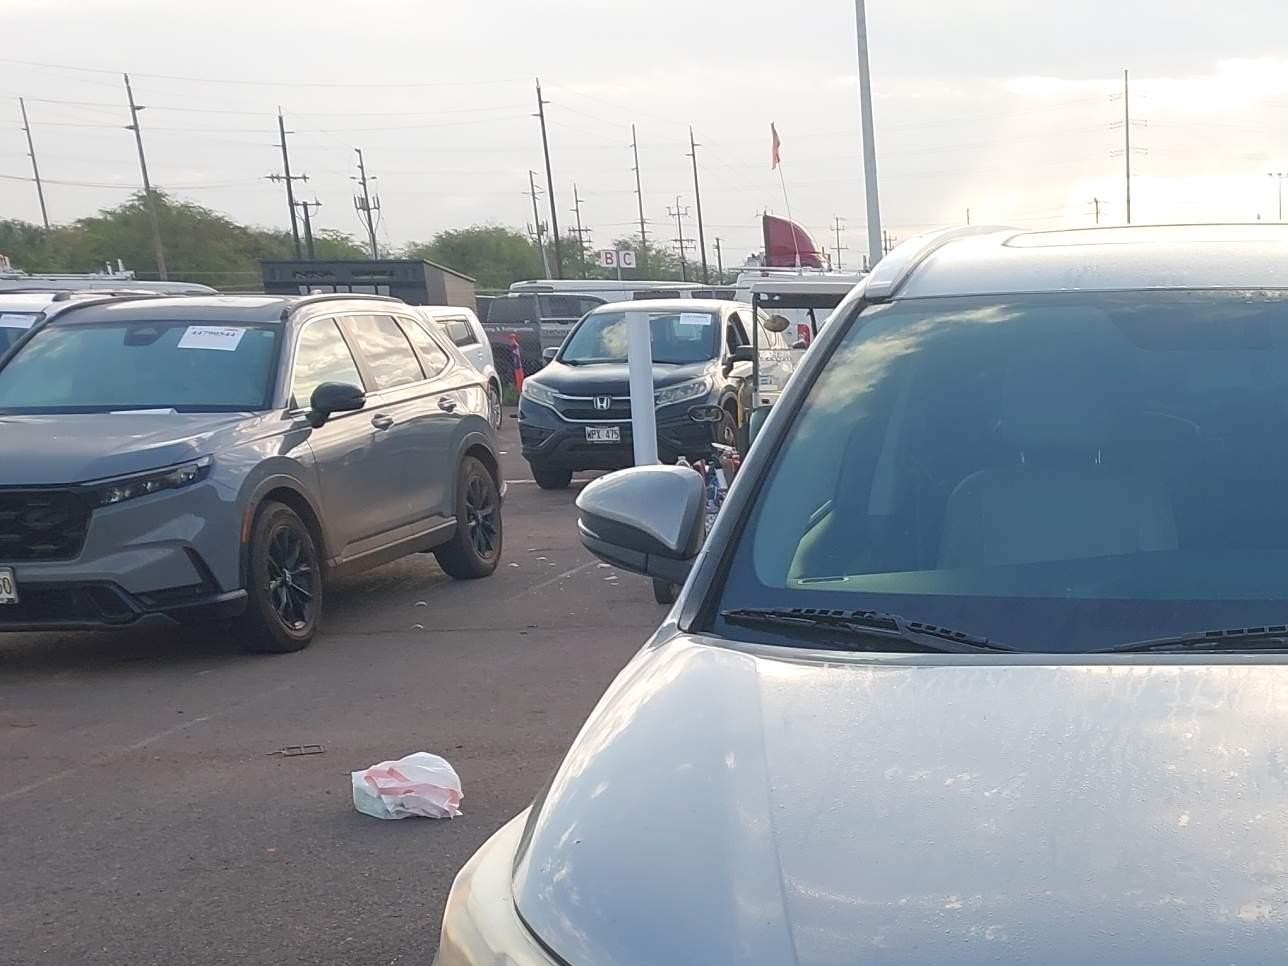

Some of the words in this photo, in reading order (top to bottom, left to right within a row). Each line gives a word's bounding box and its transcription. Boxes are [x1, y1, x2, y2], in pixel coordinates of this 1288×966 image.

[604, 251, 614, 265] B
[623, 252, 632, 266] C
[605, 429, 619, 440] 475
